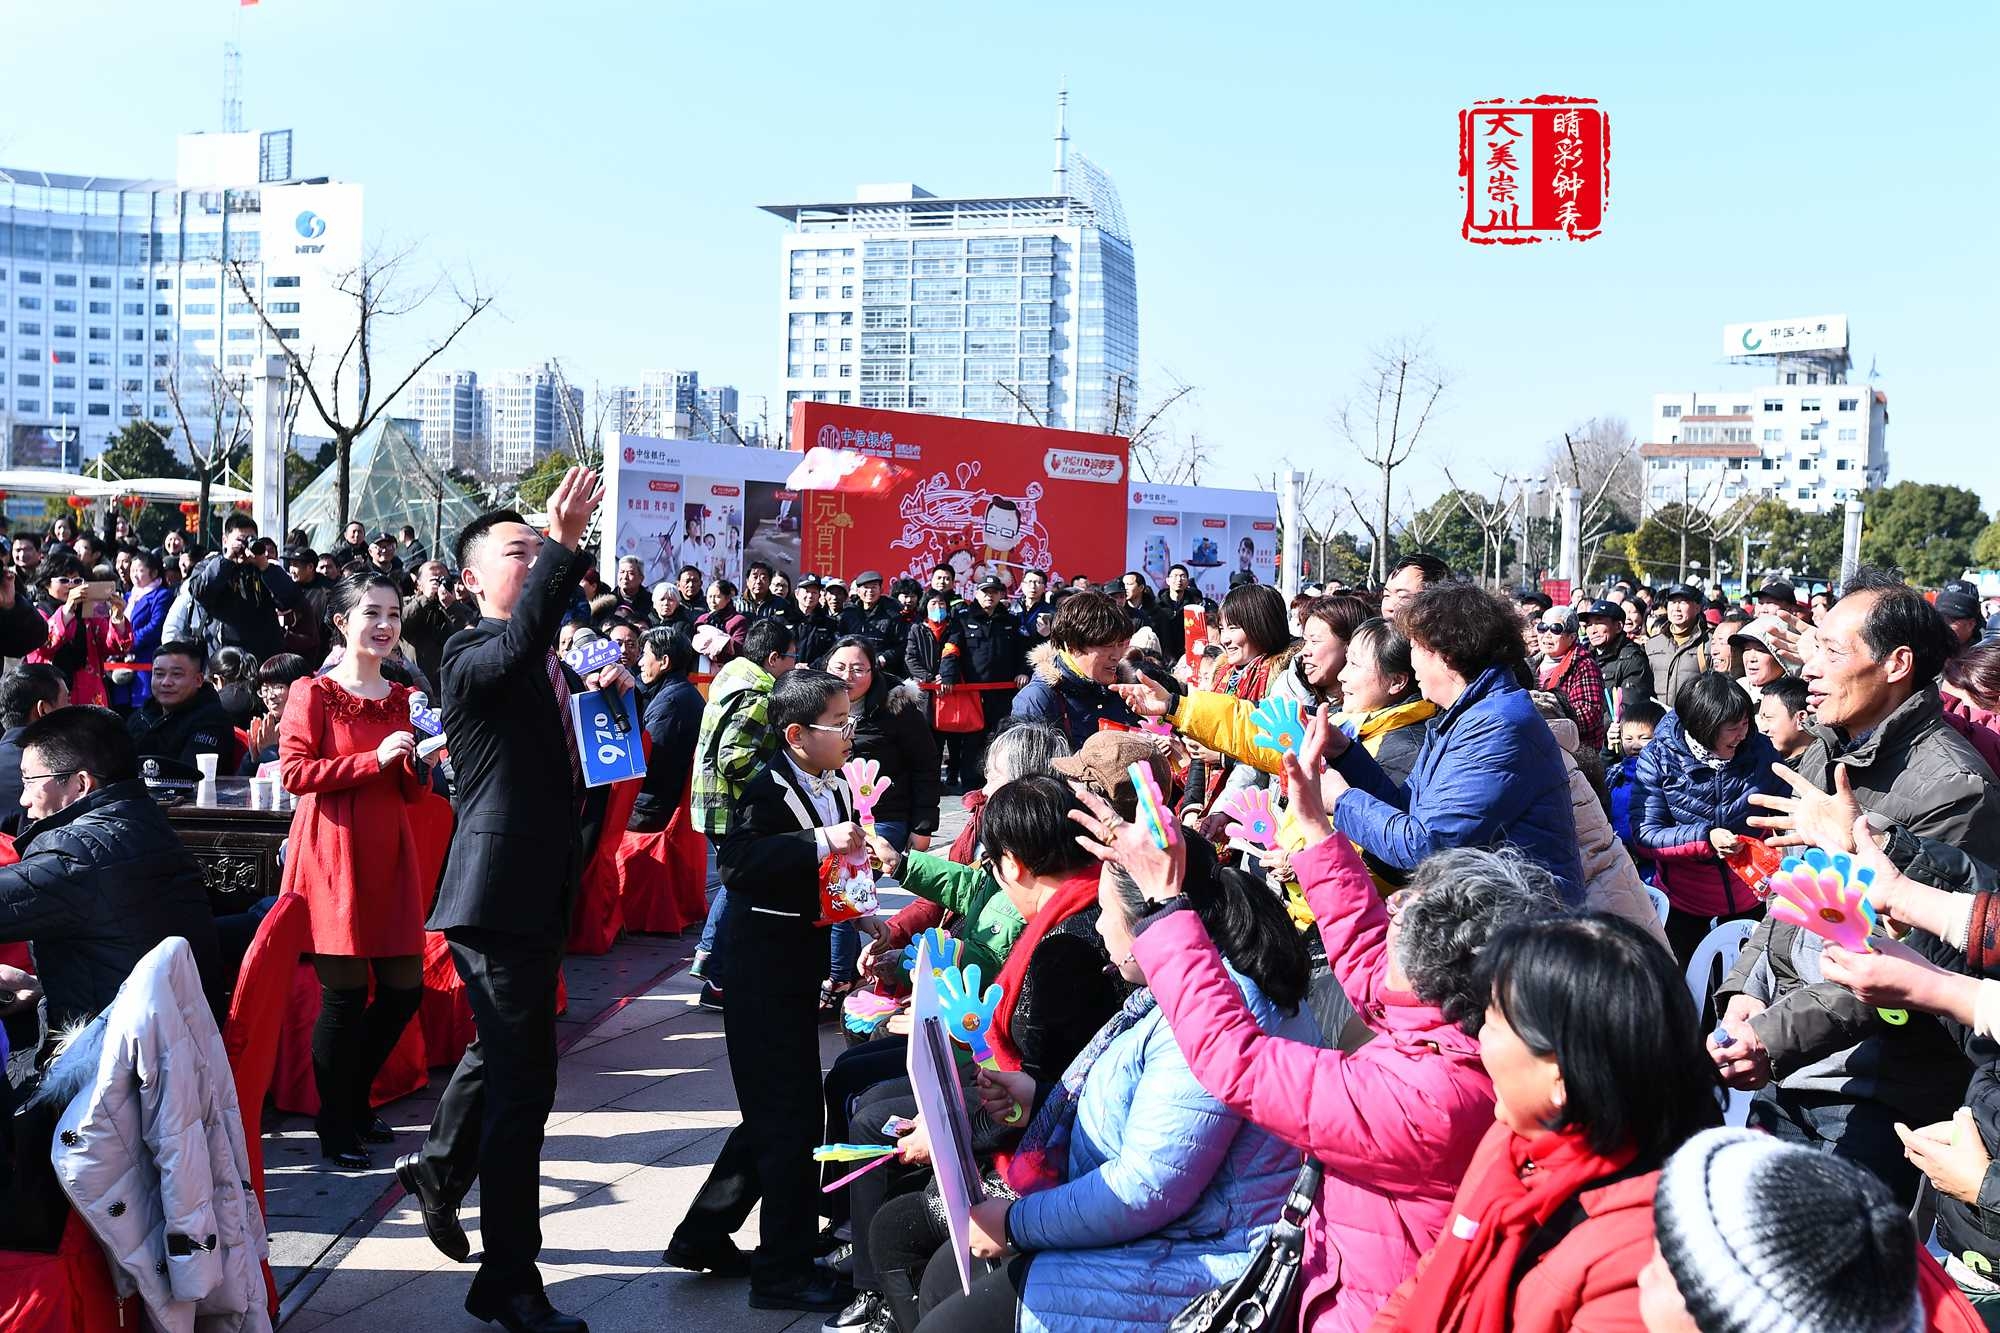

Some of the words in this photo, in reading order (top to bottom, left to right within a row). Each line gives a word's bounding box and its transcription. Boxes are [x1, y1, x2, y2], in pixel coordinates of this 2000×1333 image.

[1770, 323, 1828, 339] 中国人寿
[840, 426, 894, 450] 中信银行
[636, 448, 667, 462] 中信银行
[814, 495, 837, 578] 元宵节
[566, 638, 609, 670] 97.0
[594, 712, 626, 765] 97.0
